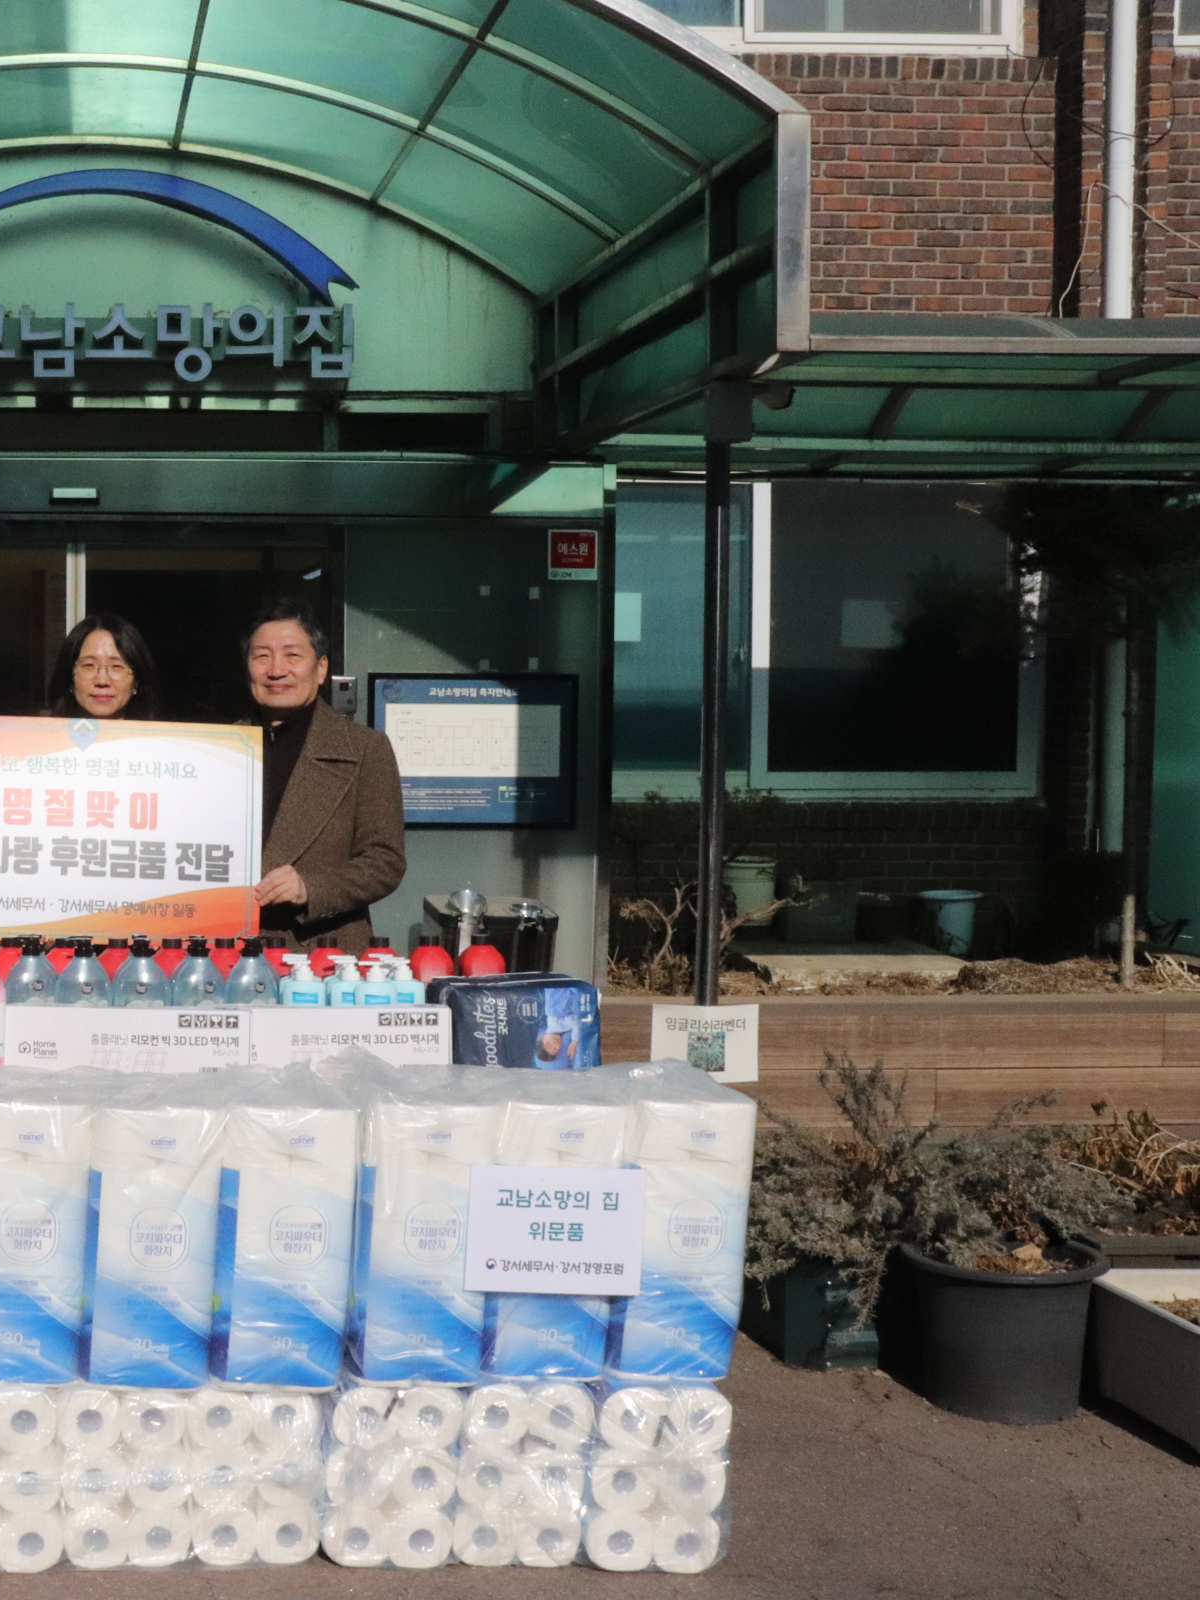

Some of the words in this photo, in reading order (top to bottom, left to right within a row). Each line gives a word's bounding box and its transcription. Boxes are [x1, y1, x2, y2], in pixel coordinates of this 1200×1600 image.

[557, 542, 589, 556] 에스원
[428, 687, 478, 698] 교남소망의집
[25, 756, 80, 776] 행복한
[85, 758, 120, 777] 명절
[126, 760, 199, 780] 보내세요
[50, 836, 167, 880] 후원금품
[175, 842, 234, 883] 전달
[57, 898, 118, 914] 강서세무서
[121, 900, 170, 917] 명예서장
[173, 902, 197, 918] 일동
[665, 1017, 746, 1033] 잉글리쉬라벤더
[33, 1040, 57, 1048] Home
[91, 1034, 129, 1046] 홈플래닛
[131, 1034, 159, 1047] 리모컨
[162, 1035, 171, 1047] 빅
[173, 1036, 187, 1046] 3D
[189, 1037, 209, 1047] LED
[210, 1036, 240, 1048] 벽시계
[291, 1034, 329, 1046] 홈플래닛
[331, 1034, 359, 1046] 리모컨
[362, 1034, 371, 1046] 빅
[373, 1035, 388, 1044] 3D
[389, 1035, 409, 1044] LED
[410, 1033, 440, 1045] 벽시계
[33, 1048, 58, 1056] Planet
[19, 1132, 44, 1142] comet
[290, 1136, 315, 1146] comet
[426, 1132, 451, 1141] comet
[559, 1131, 584, 1140] comet
[691, 1131, 716, 1140] comet
[151, 1137, 176, 1147] comet
[496, 1188, 590, 1210] 교남소망의
[602, 1191, 619, 1211] 집
[4, 1227, 52, 1239] 코지파우더
[409, 1227, 456, 1239] 코지파우더
[528, 1221, 584, 1242] 위문품
[673, 1224, 719, 1236] 코지파우더
[134, 1233, 183, 1245] 코지파우더
[274, 1230, 322, 1243] 코지파우더
[681, 1236, 708, 1247] 화장지
[13, 1239, 42, 1251] 화장지
[143, 1245, 172, 1257] 화장지
[283, 1243, 312, 1254] 화장지
[418, 1239, 447, 1251] 화장지
